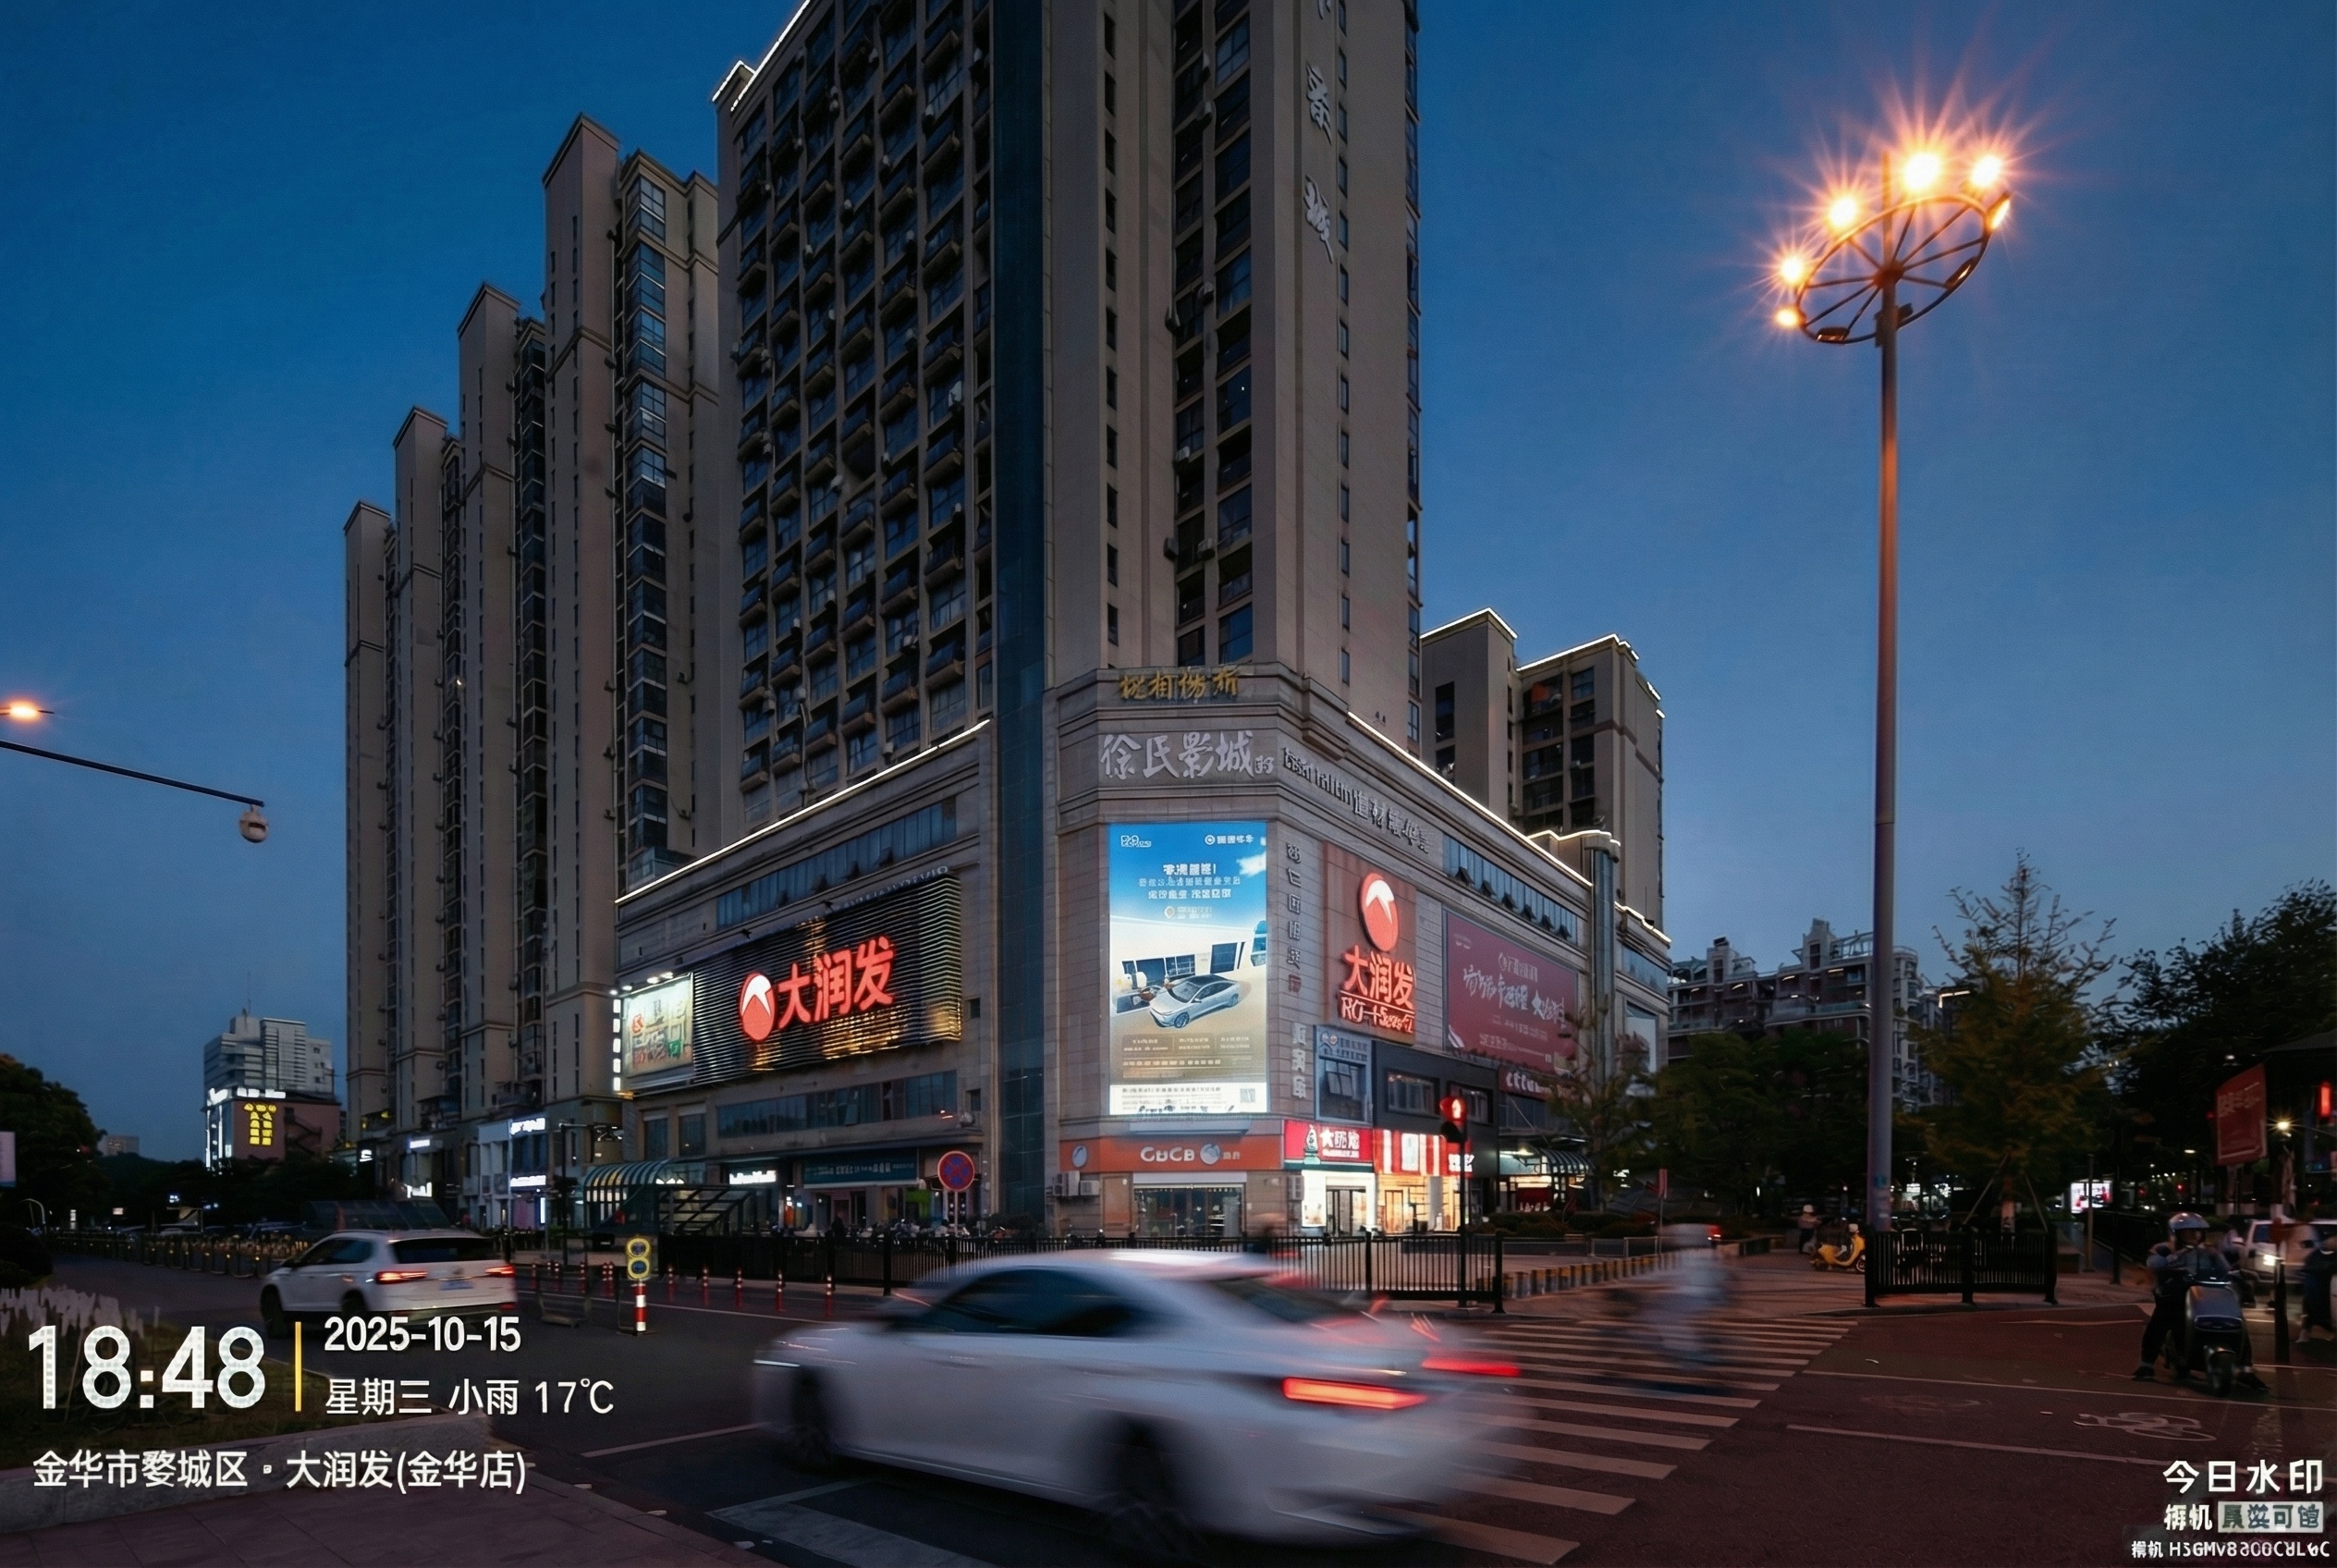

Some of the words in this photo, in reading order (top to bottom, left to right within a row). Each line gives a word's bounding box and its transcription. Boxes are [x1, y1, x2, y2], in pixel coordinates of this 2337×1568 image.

[1100, 729, 1254, 780] 徐氏影城
[777, 935, 897, 1030] 大润发
[1343, 944, 1414, 1011] 大润发
